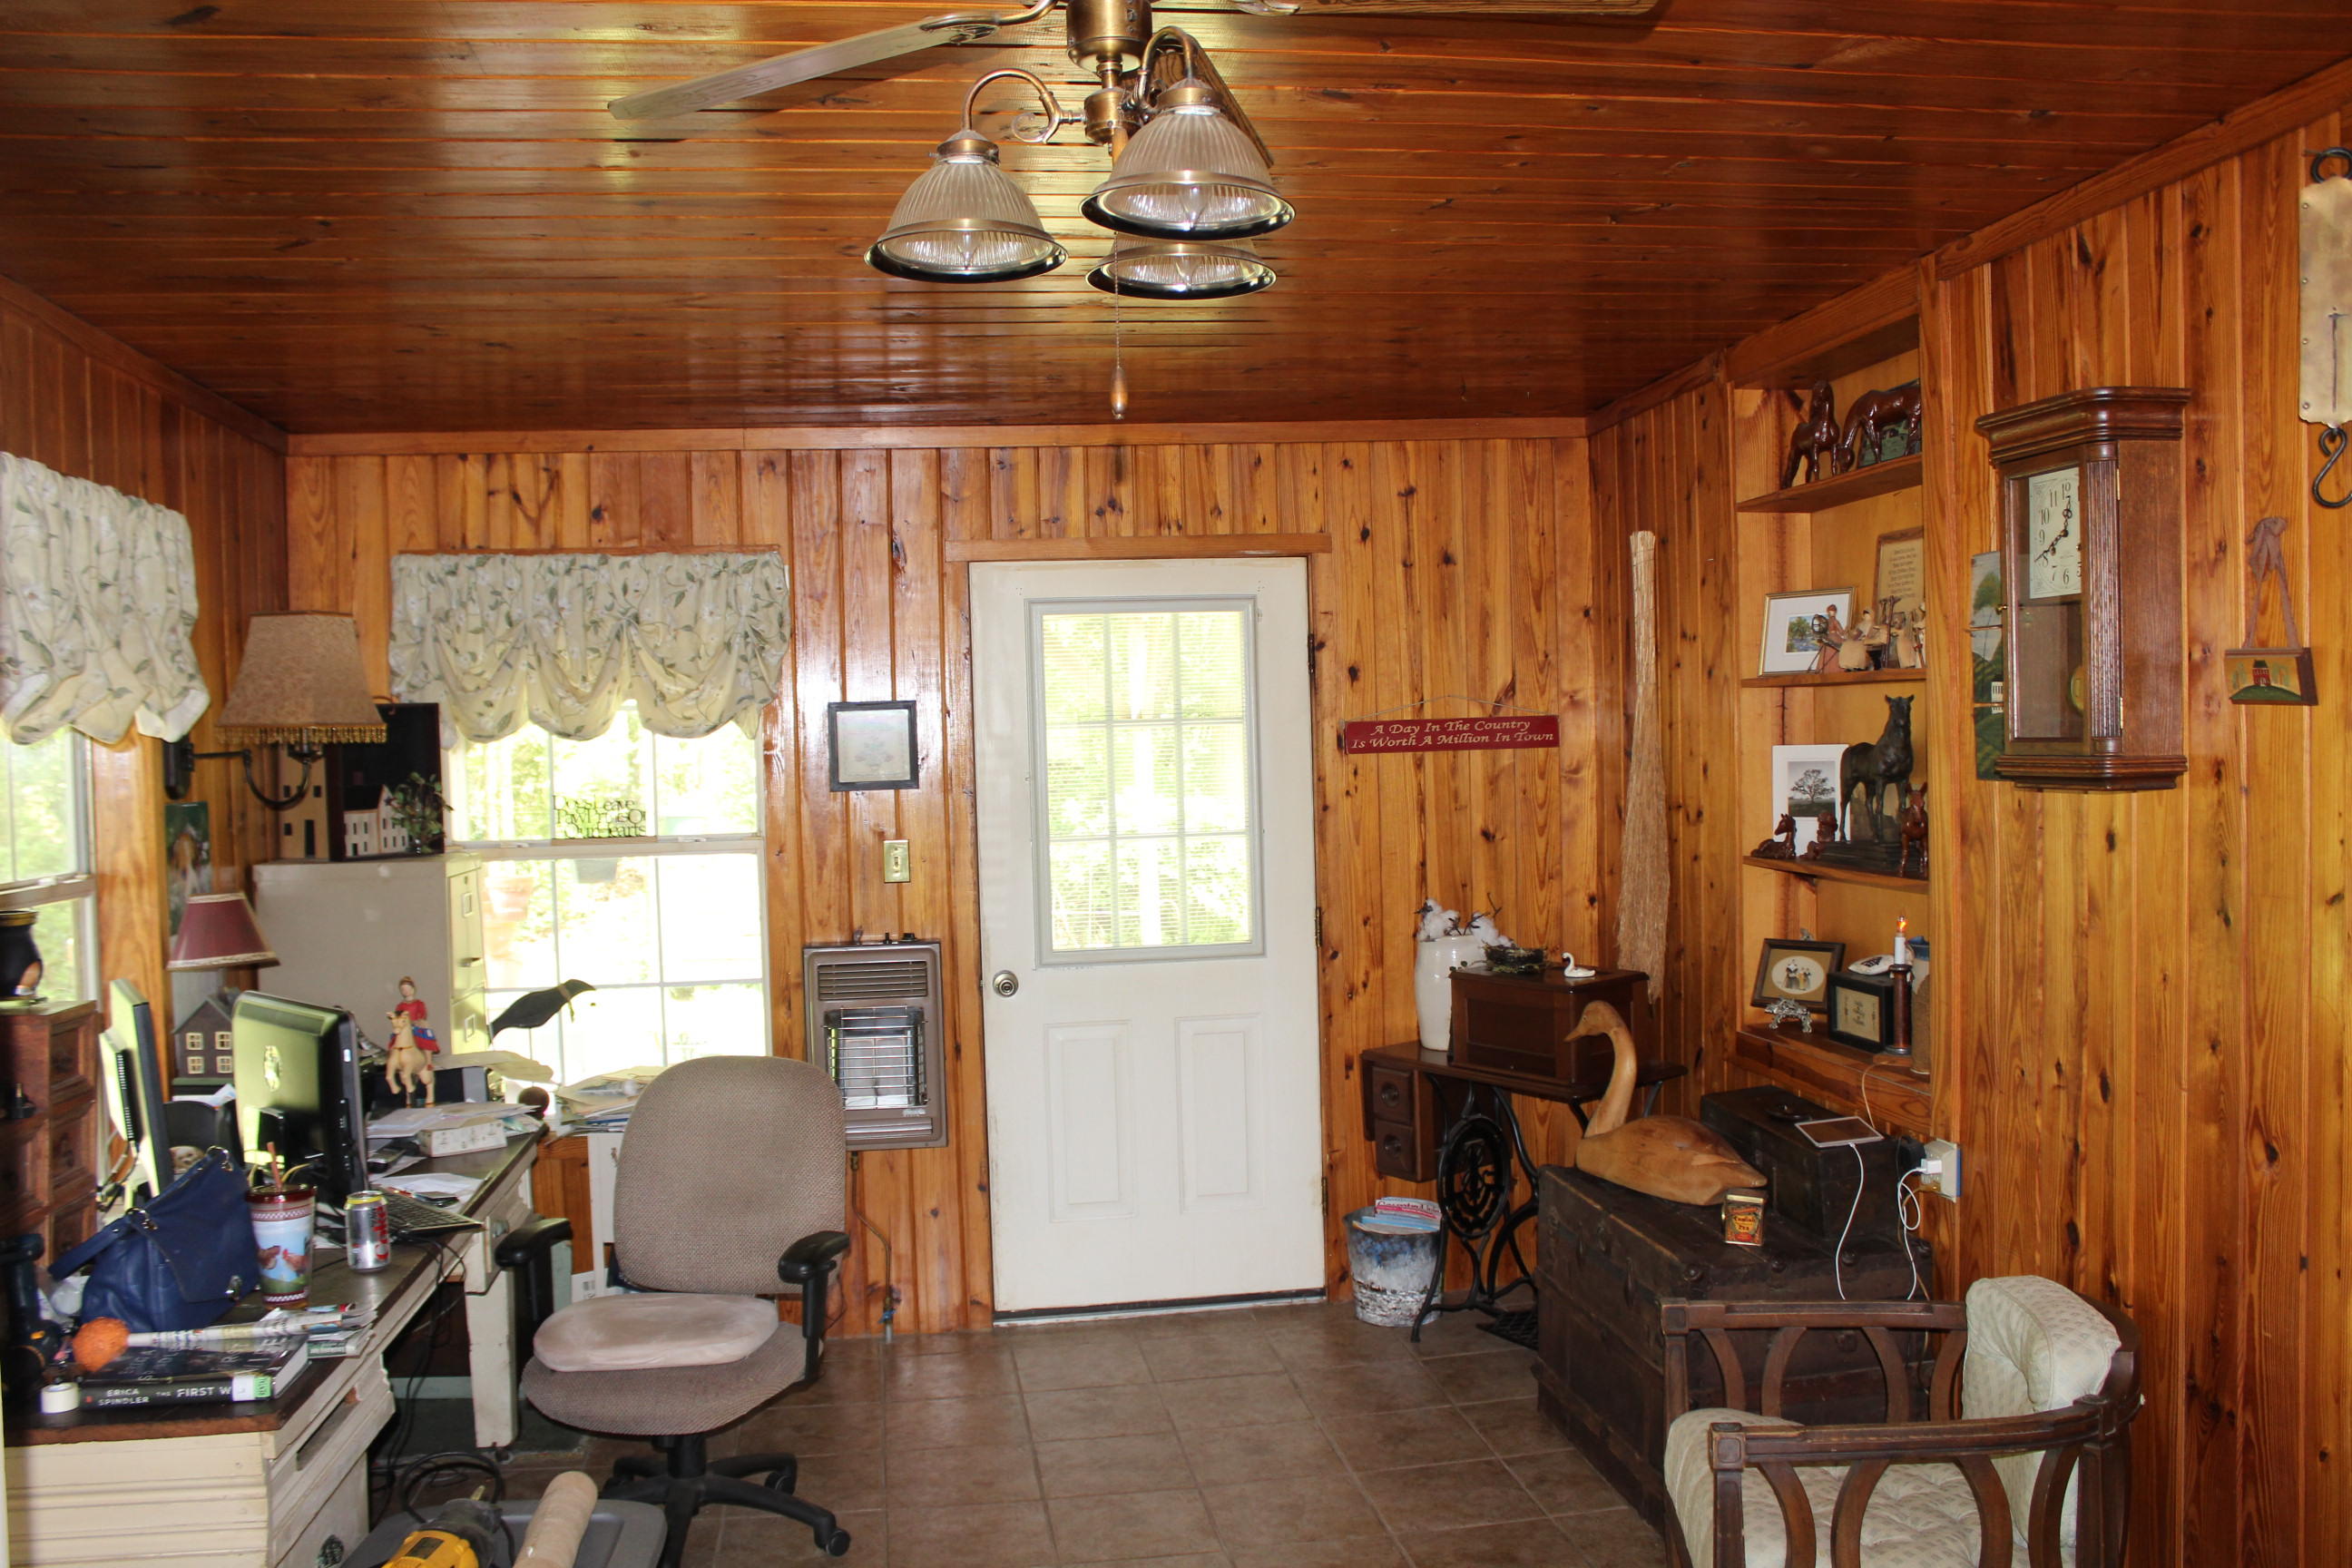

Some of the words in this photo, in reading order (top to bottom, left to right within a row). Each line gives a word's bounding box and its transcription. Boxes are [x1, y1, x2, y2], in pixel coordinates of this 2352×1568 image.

[2050, 489, 2058, 508] 11
[2040, 507, 2051, 526] 10
[2039, 529, 2045, 545] 9
[2051, 565, 2057, 582] 7
[2063, 568, 2070, 585] 6
[1370, 724, 1385, 736] A
[1388, 724, 1420, 736] Day
[1424, 722, 1440, 732] In
[1444, 720, 1470, 731] The
[1474, 720, 1531, 731] Country
[1351, 740, 1367, 749] Is
[1369, 735, 1416, 748] Worth
[1418, 735, 1433, 746] A
[1437, 733, 1489, 745] Million
[1494, 732, 1511, 742] In
[1514, 731, 1554, 741] Town
[106, 1387, 141, 1396] ERICA
[176, 1386, 214, 1398] FIRST
[98, 1395, 150, 1406] SPINDLER
